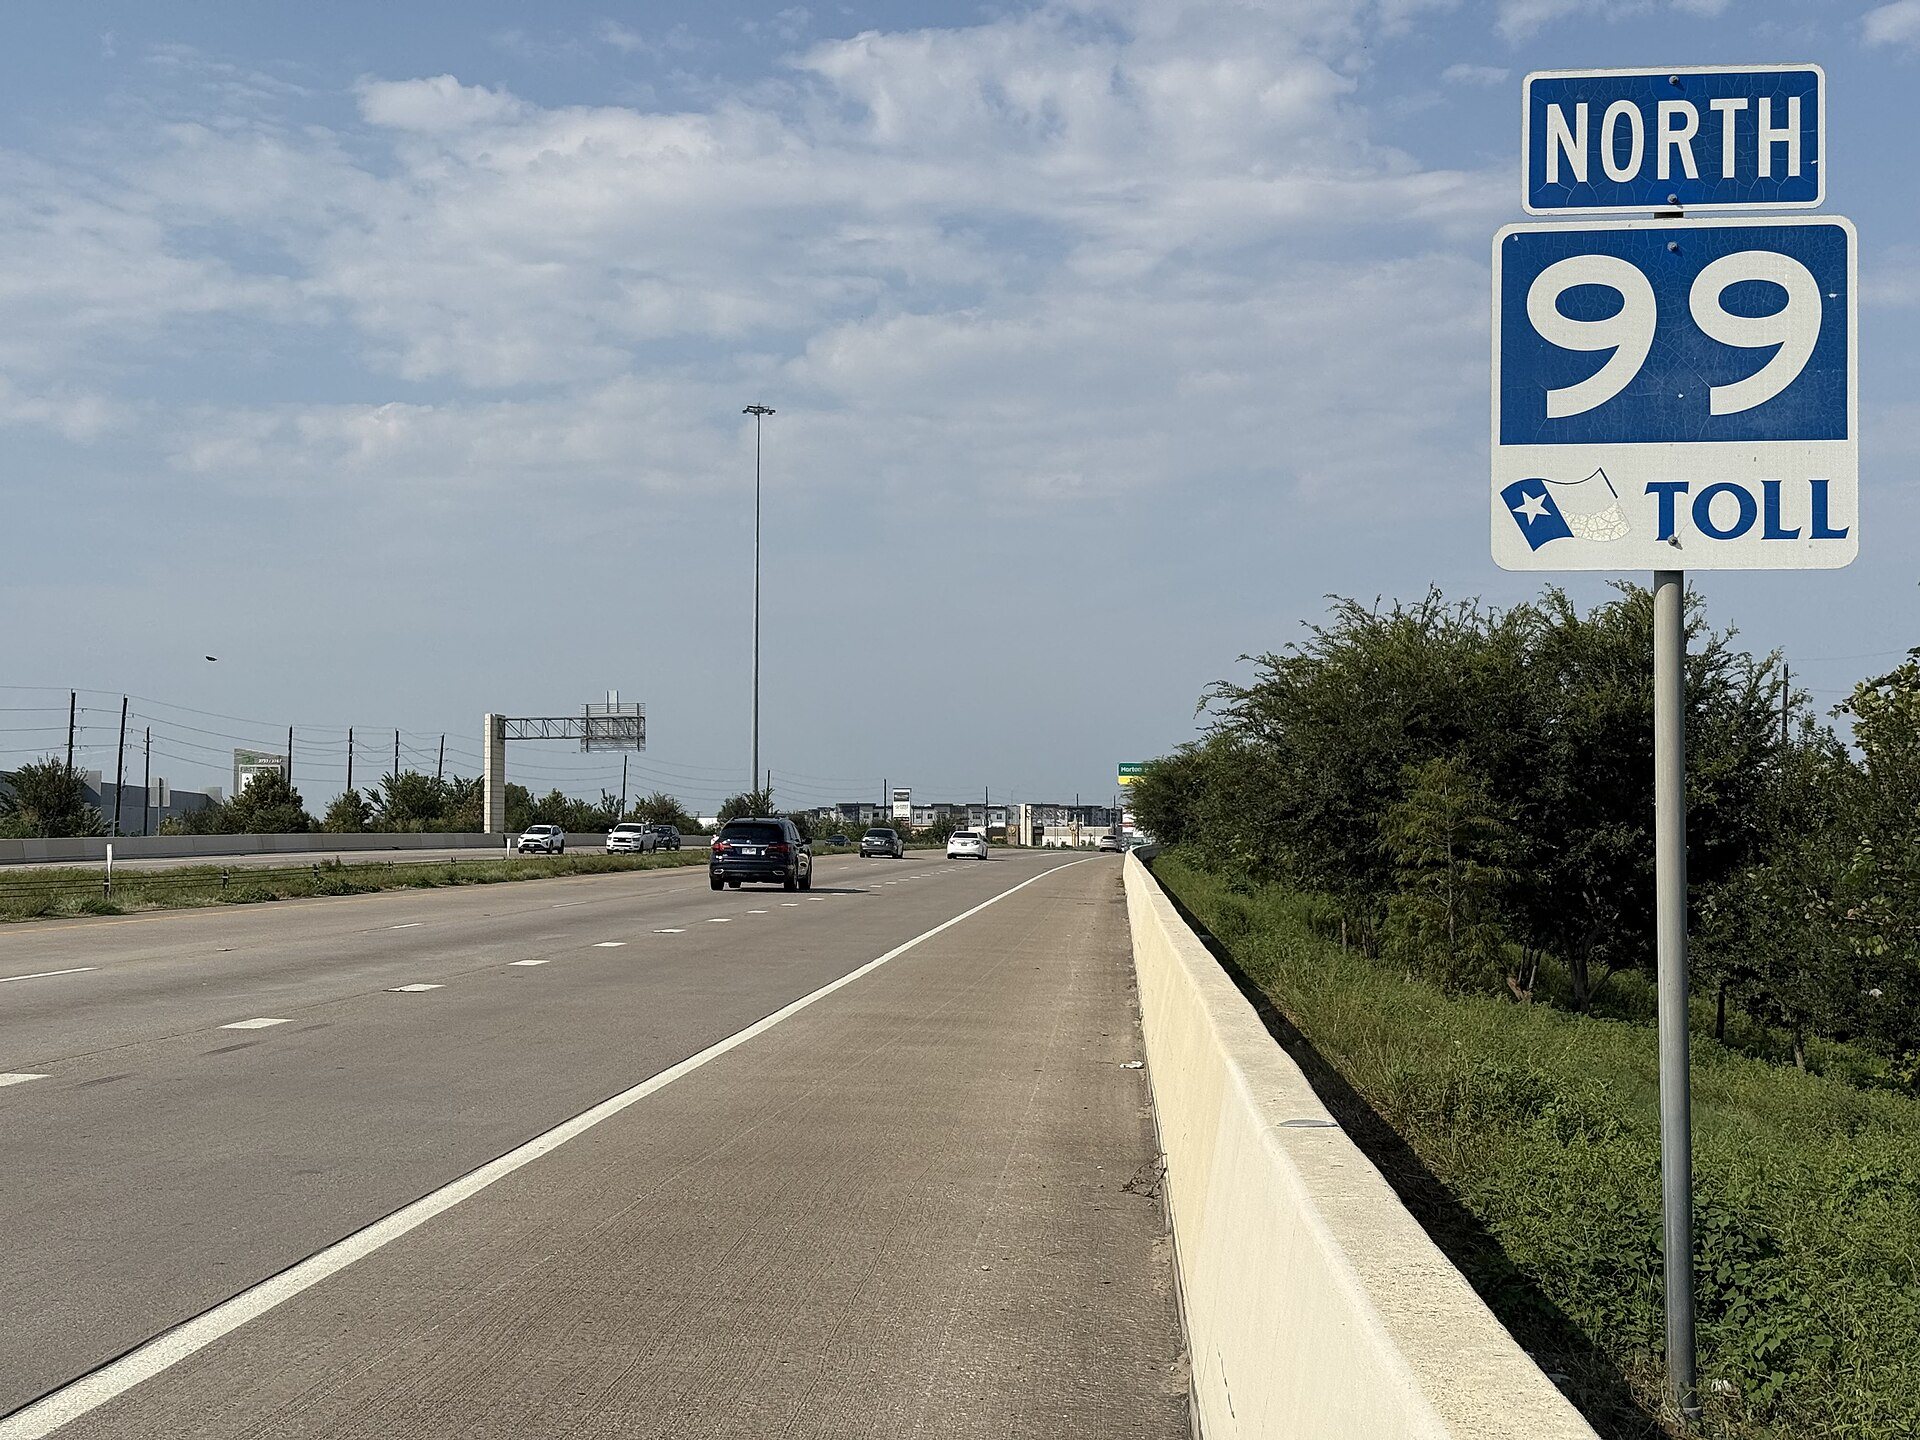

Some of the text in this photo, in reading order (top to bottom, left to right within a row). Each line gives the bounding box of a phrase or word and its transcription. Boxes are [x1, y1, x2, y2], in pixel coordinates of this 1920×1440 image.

[1546, 97, 1801, 184] NORTH
[1526, 250, 1822, 419] 99
[1645, 479, 1850, 542] TOLL
